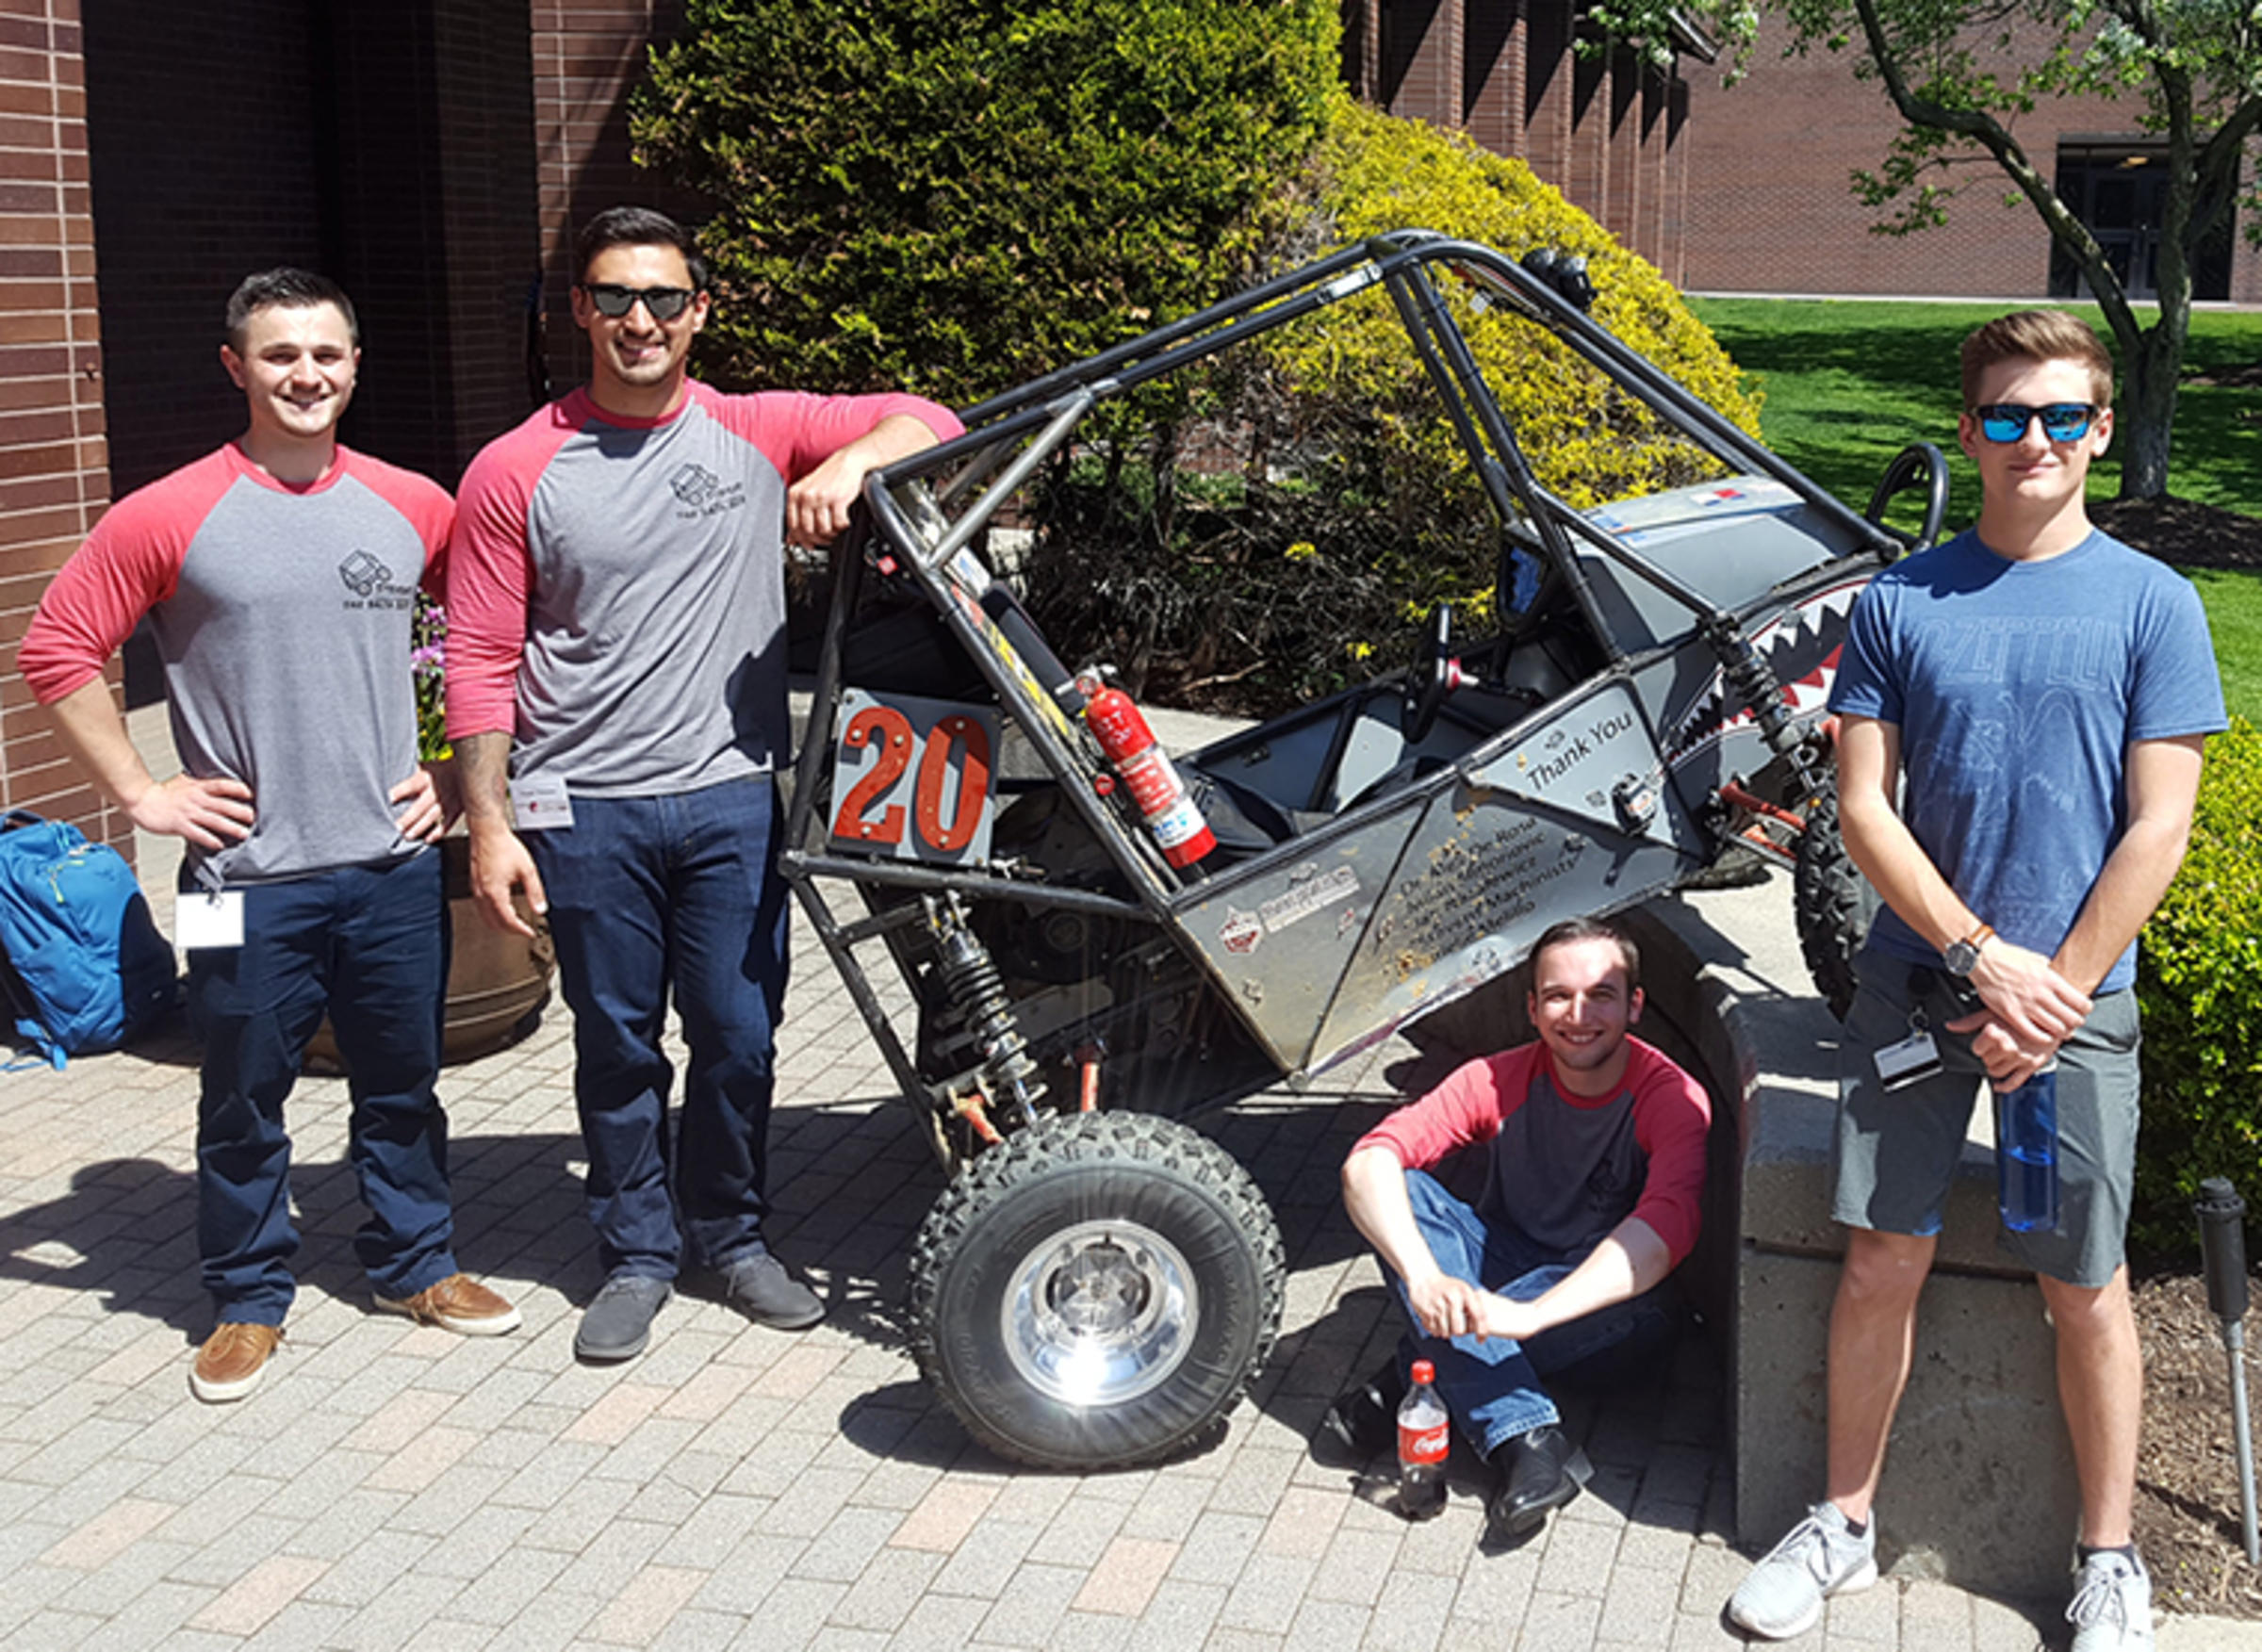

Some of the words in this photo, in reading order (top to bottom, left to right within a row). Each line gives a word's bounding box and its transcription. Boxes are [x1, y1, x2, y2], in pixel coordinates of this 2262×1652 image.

[833, 706, 991, 852] 20
[1527, 737, 1591, 791] Thank
[1589, 712, 1632, 744] You
